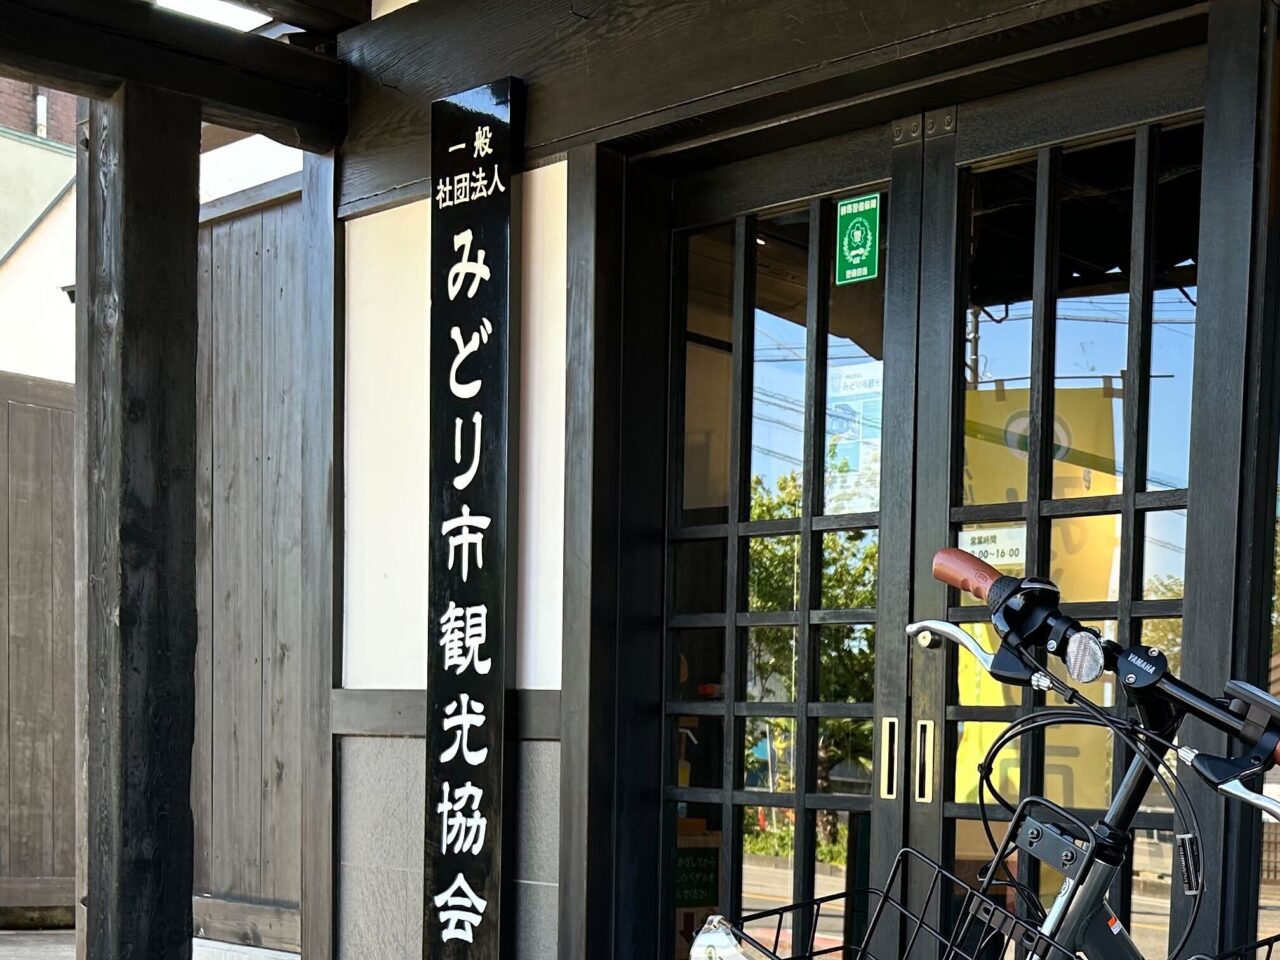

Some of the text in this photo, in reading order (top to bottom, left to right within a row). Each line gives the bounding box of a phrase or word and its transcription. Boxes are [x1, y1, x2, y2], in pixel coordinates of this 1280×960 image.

[448, 125, 493, 159] 一般
[436, 163, 506, 209] 社団法人
[434, 228, 492, 944] みどり市観光協会
[1127, 652, 1156, 675] YAMAHA
